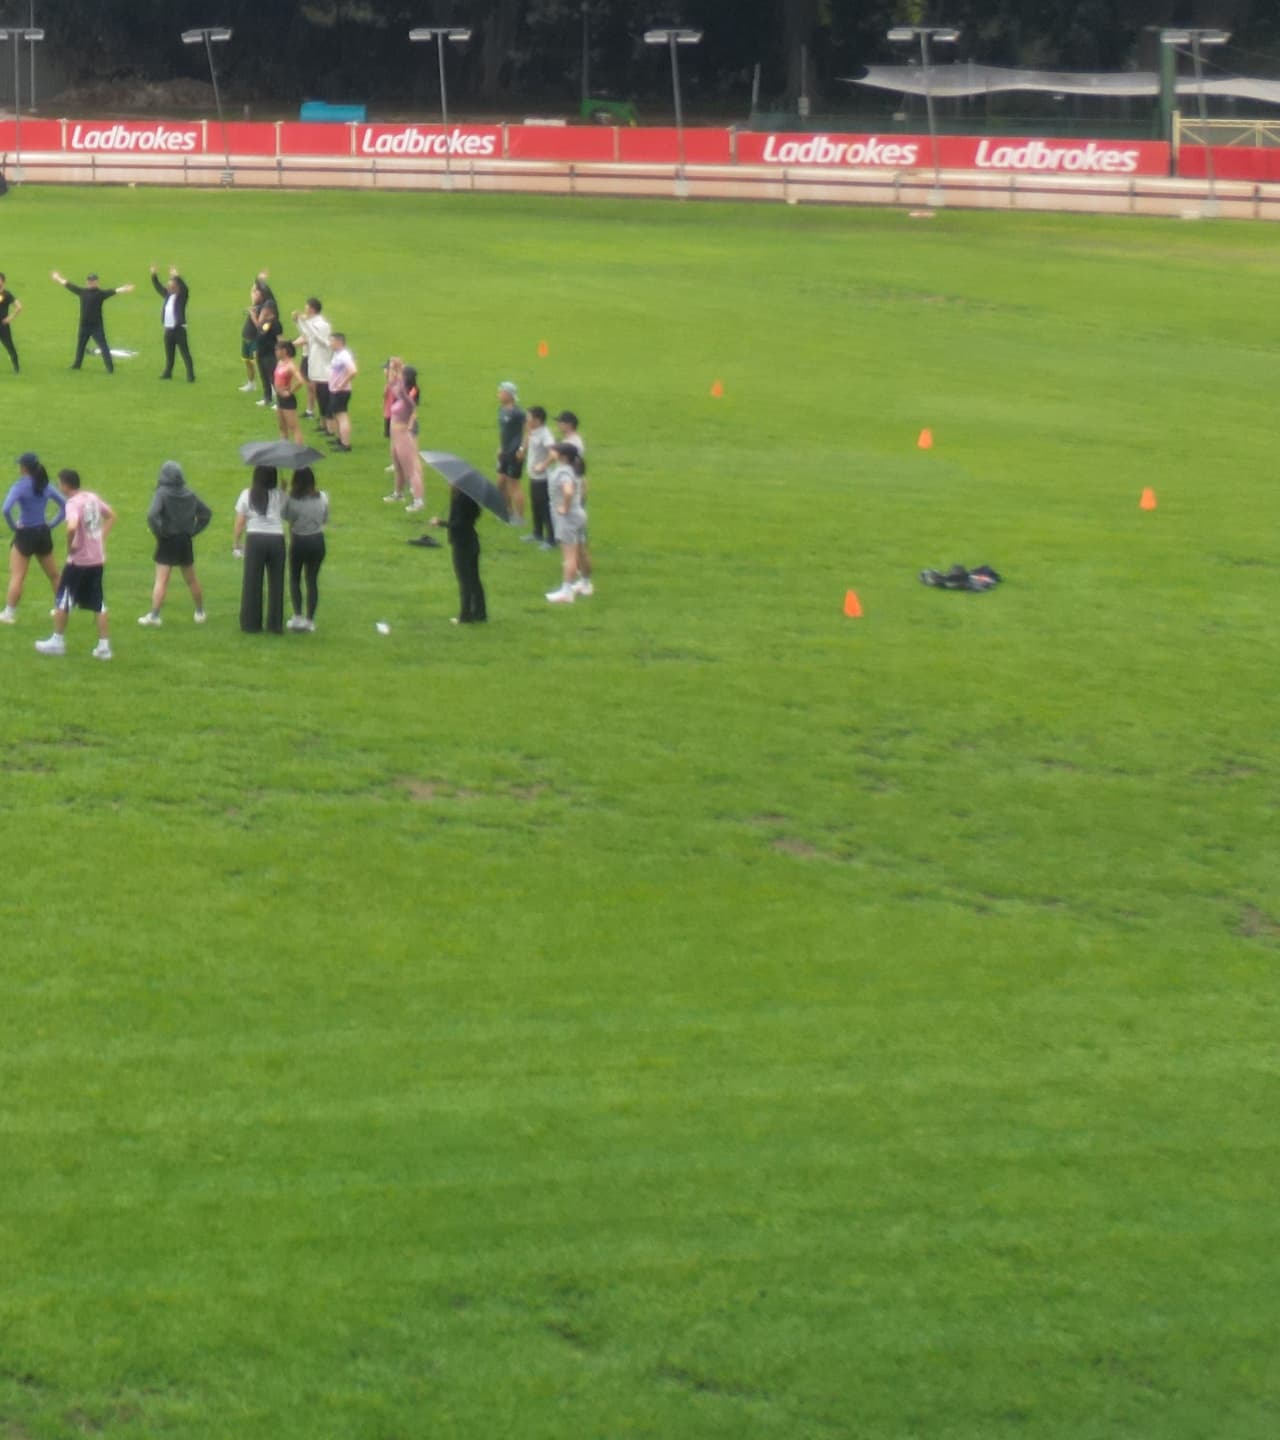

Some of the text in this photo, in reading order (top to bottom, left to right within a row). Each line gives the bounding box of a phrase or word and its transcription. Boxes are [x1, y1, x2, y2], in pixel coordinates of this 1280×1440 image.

[71, 125, 198, 151] Ladbrokes
[361, 127, 497, 155] Ladbrokes
[763, 135, 919, 165] Ladbrokes
[975, 139, 1139, 172] Ladbrokes
